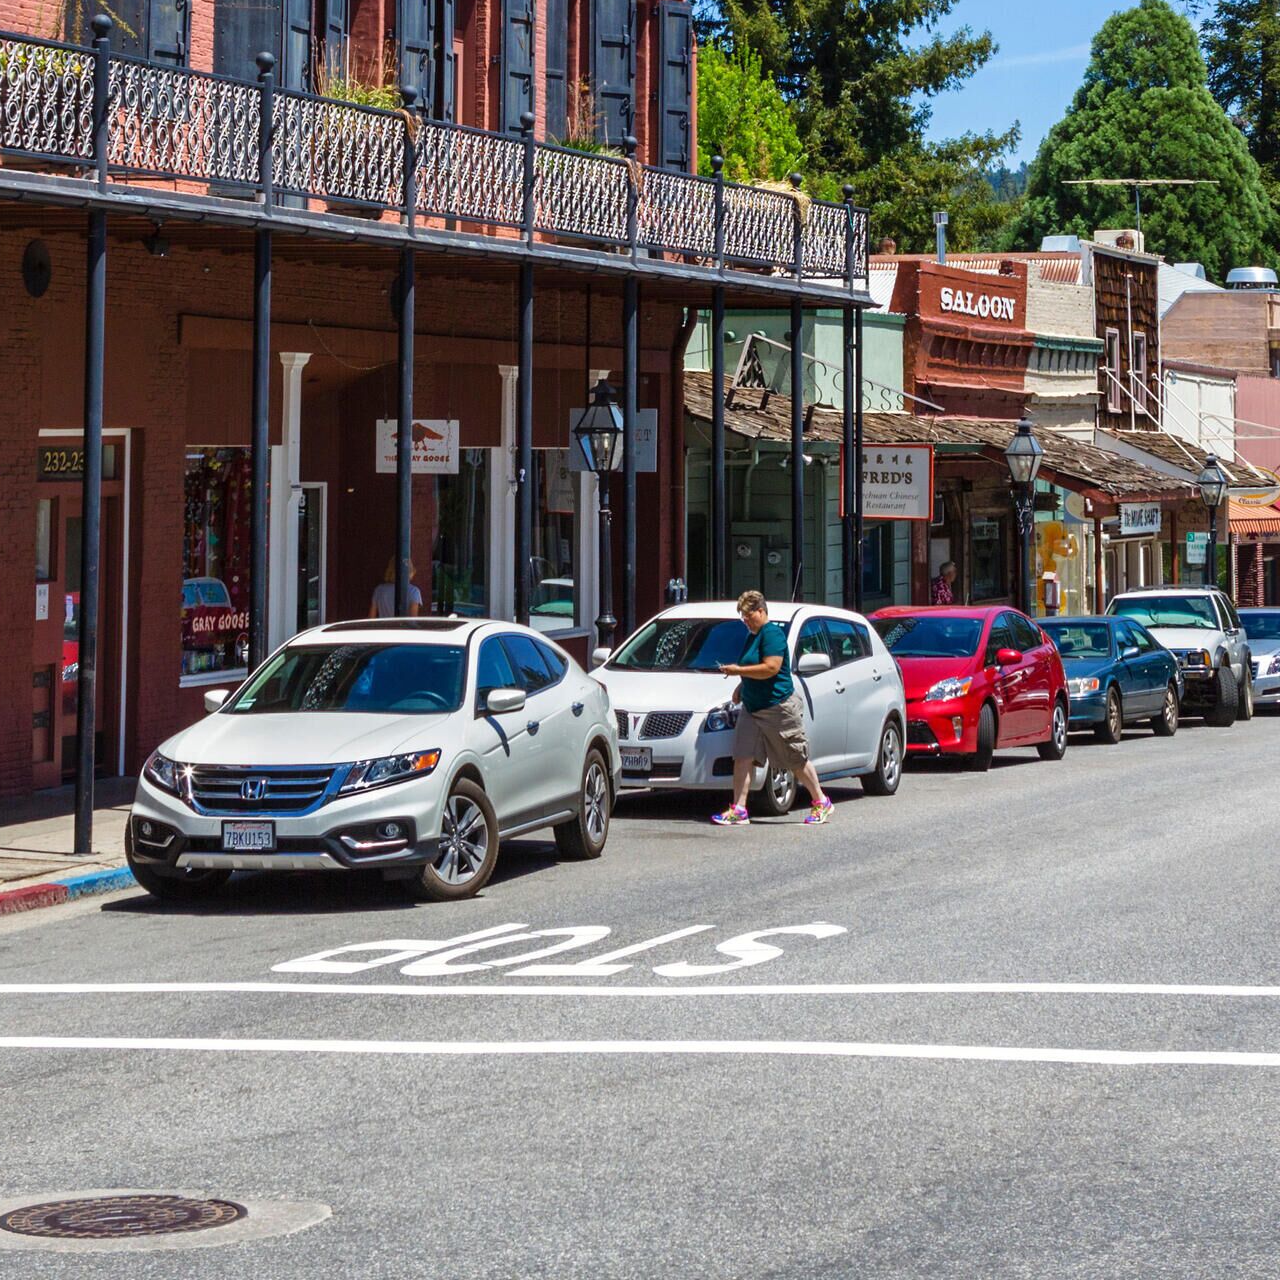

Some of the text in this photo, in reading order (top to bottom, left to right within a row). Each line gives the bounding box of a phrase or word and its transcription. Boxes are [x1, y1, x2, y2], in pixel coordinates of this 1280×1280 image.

[941, 287, 1016, 320] SALOON
[44, 451, 85, 472] 232-23
[866, 500, 906, 512] Restaurant
[192, 611, 250, 633] GRAY GOOSE
[226, 831, 271, 846] 7BKU153
[271, 922, 848, 977] STOP
